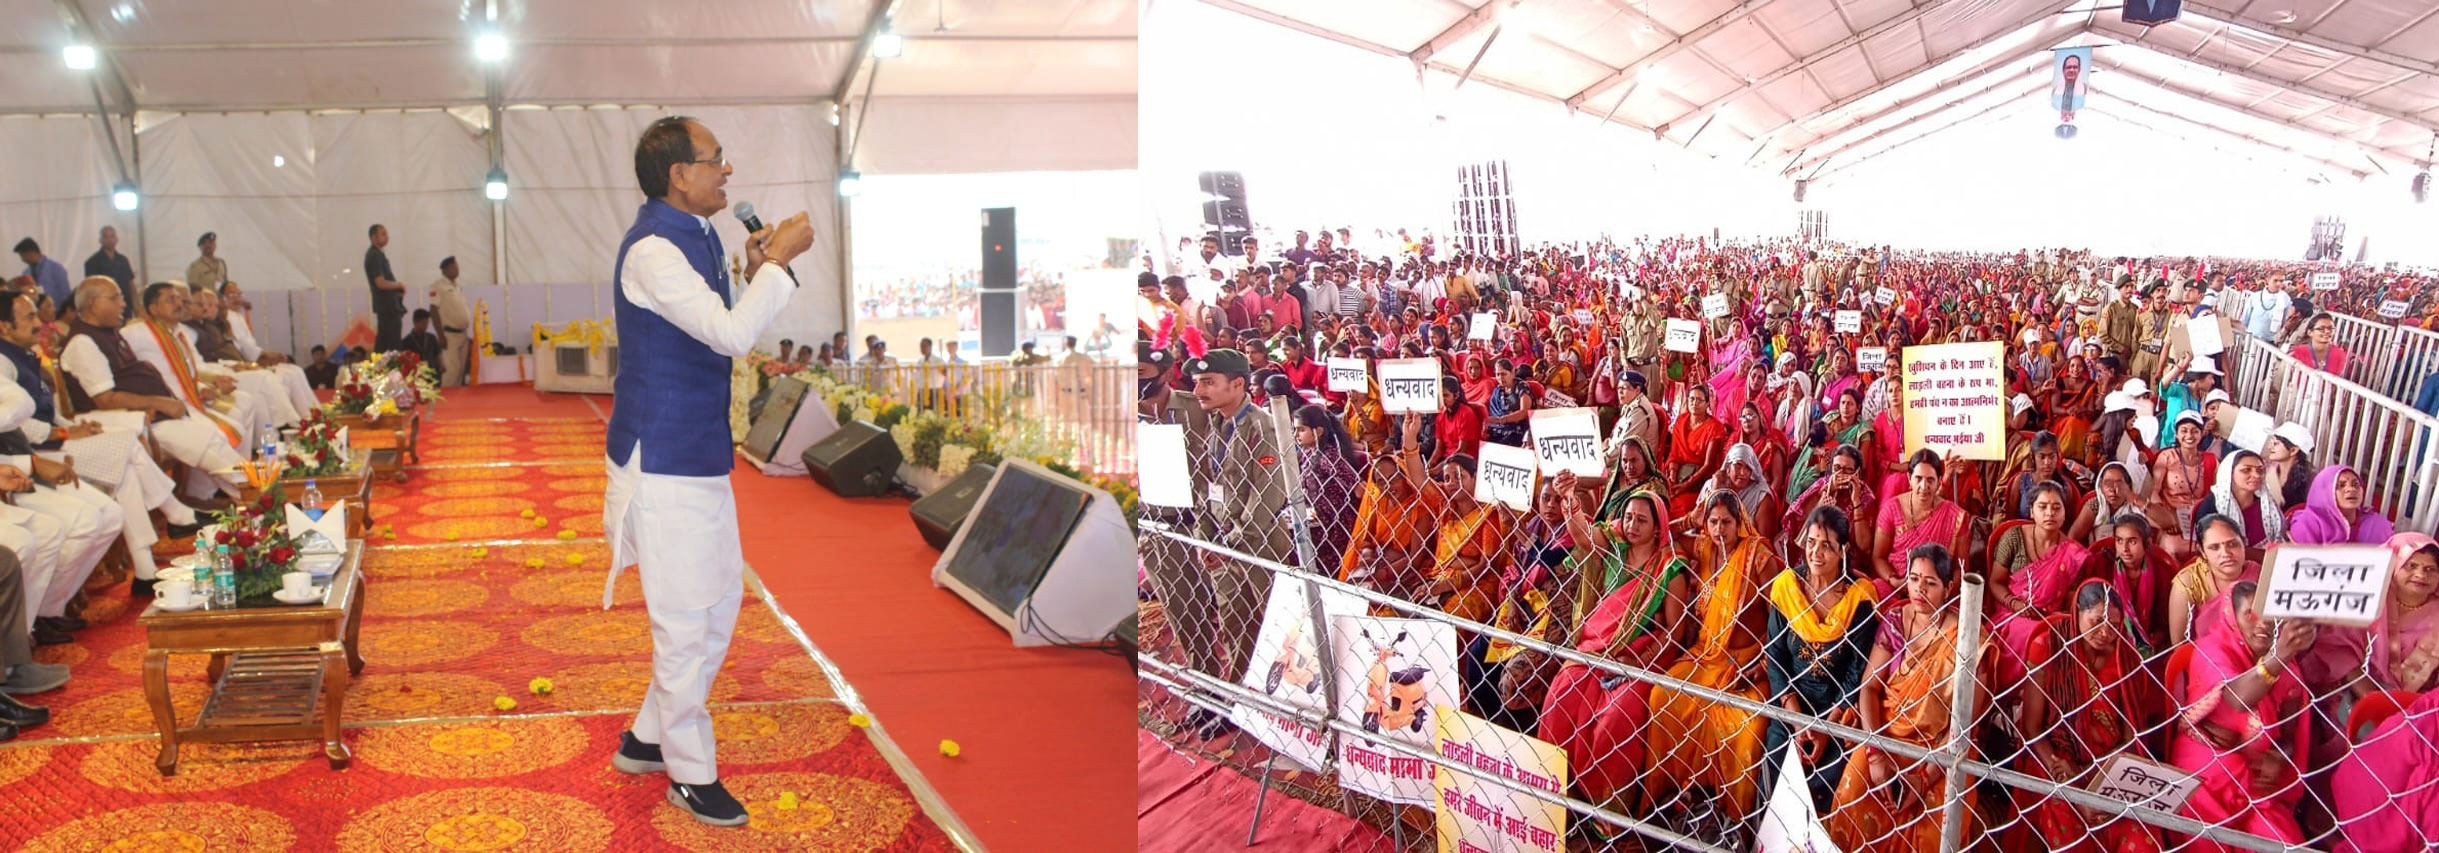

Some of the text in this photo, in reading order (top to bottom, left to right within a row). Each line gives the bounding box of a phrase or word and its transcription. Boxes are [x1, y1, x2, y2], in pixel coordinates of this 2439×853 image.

[1331, 367, 1365, 382] धन्यवाद
[1950, 358, 1964, 370] दिन
[1384, 377, 1436, 400] धन्यवाद
[1539, 434, 1596, 462] धन्यवाद
[1484, 459, 1532, 493] धन्यवाद
[2291, 558, 2375, 581] जिला
[2274, 585, 2375, 614] मऊगंज
[1345, 744, 1387, 776] धन्यवाद
[1389, 756, 1424, 780] मामा
[2119, 766, 2182, 796] जिला
[1464, 794, 1492, 827] जीवन
[1492, 805, 1504, 831] में
[1505, 816, 1528, 844] आई
